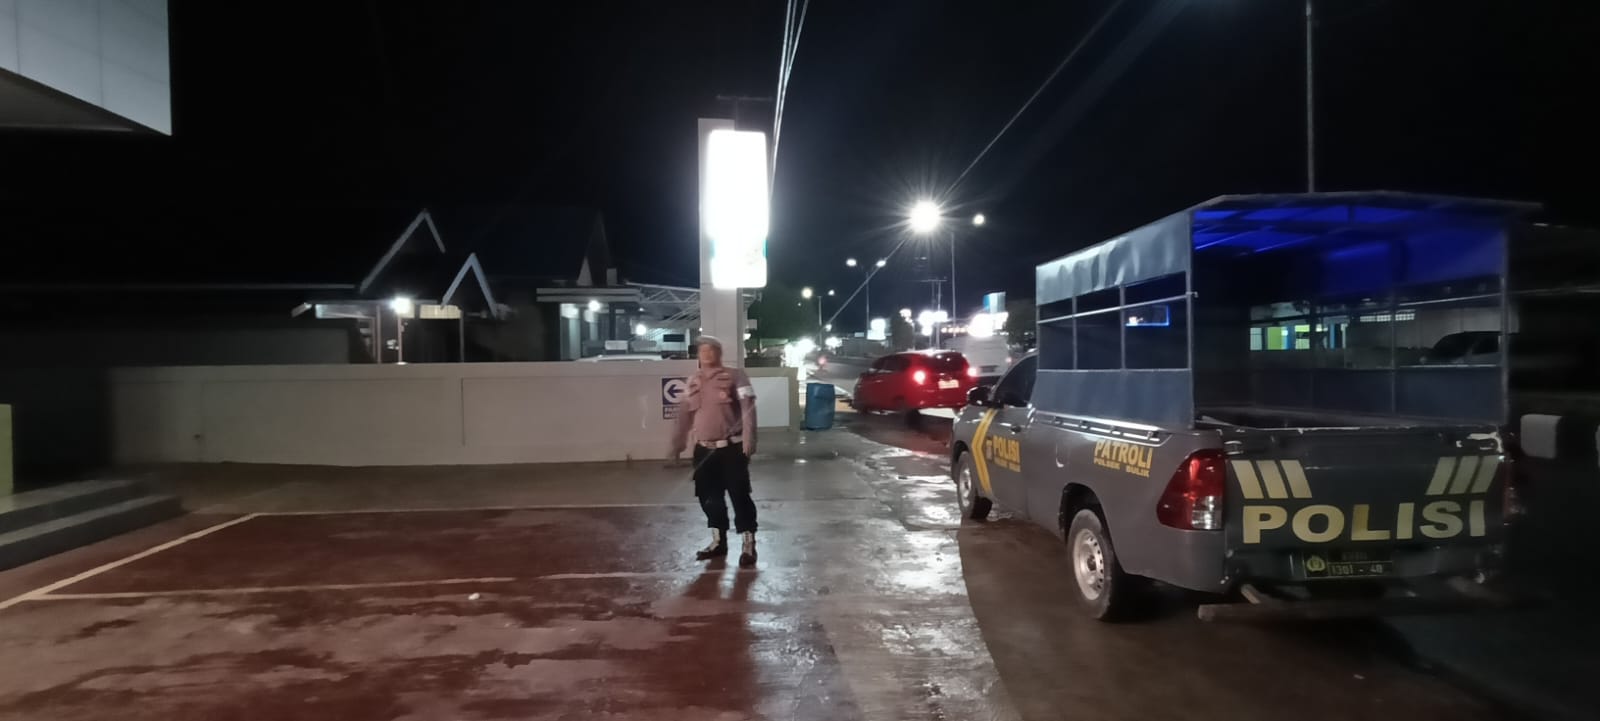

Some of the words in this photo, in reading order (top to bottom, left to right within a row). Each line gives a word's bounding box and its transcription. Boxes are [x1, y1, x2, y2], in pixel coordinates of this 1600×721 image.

[993, 435, 1020, 463] POLISI
[1094, 440, 1153, 469] PATROLI
[1243, 500, 1486, 543] POLISI
